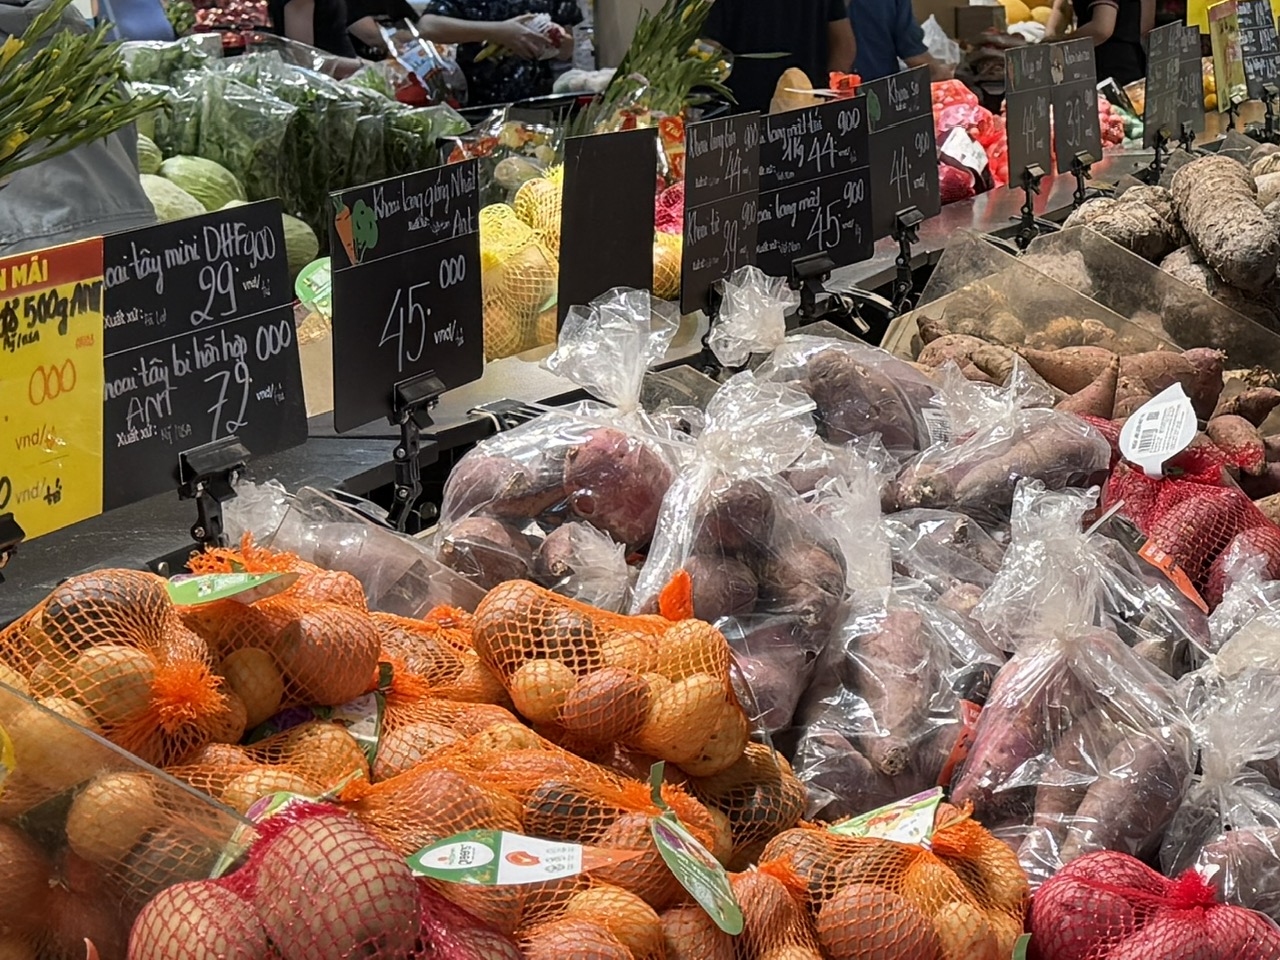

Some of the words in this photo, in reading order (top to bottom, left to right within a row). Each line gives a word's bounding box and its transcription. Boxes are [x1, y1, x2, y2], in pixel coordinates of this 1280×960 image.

[757, 204, 772, 224] oai
[11, 255, 48, 289] MÃI
[104, 255, 130, 290] oai
[129, 242, 163, 295] tây
[165, 235, 200, 268] mini
[439, 255, 466, 289] 000
[255, 320, 292, 362] 000
[28, 358, 77, 406] 000
